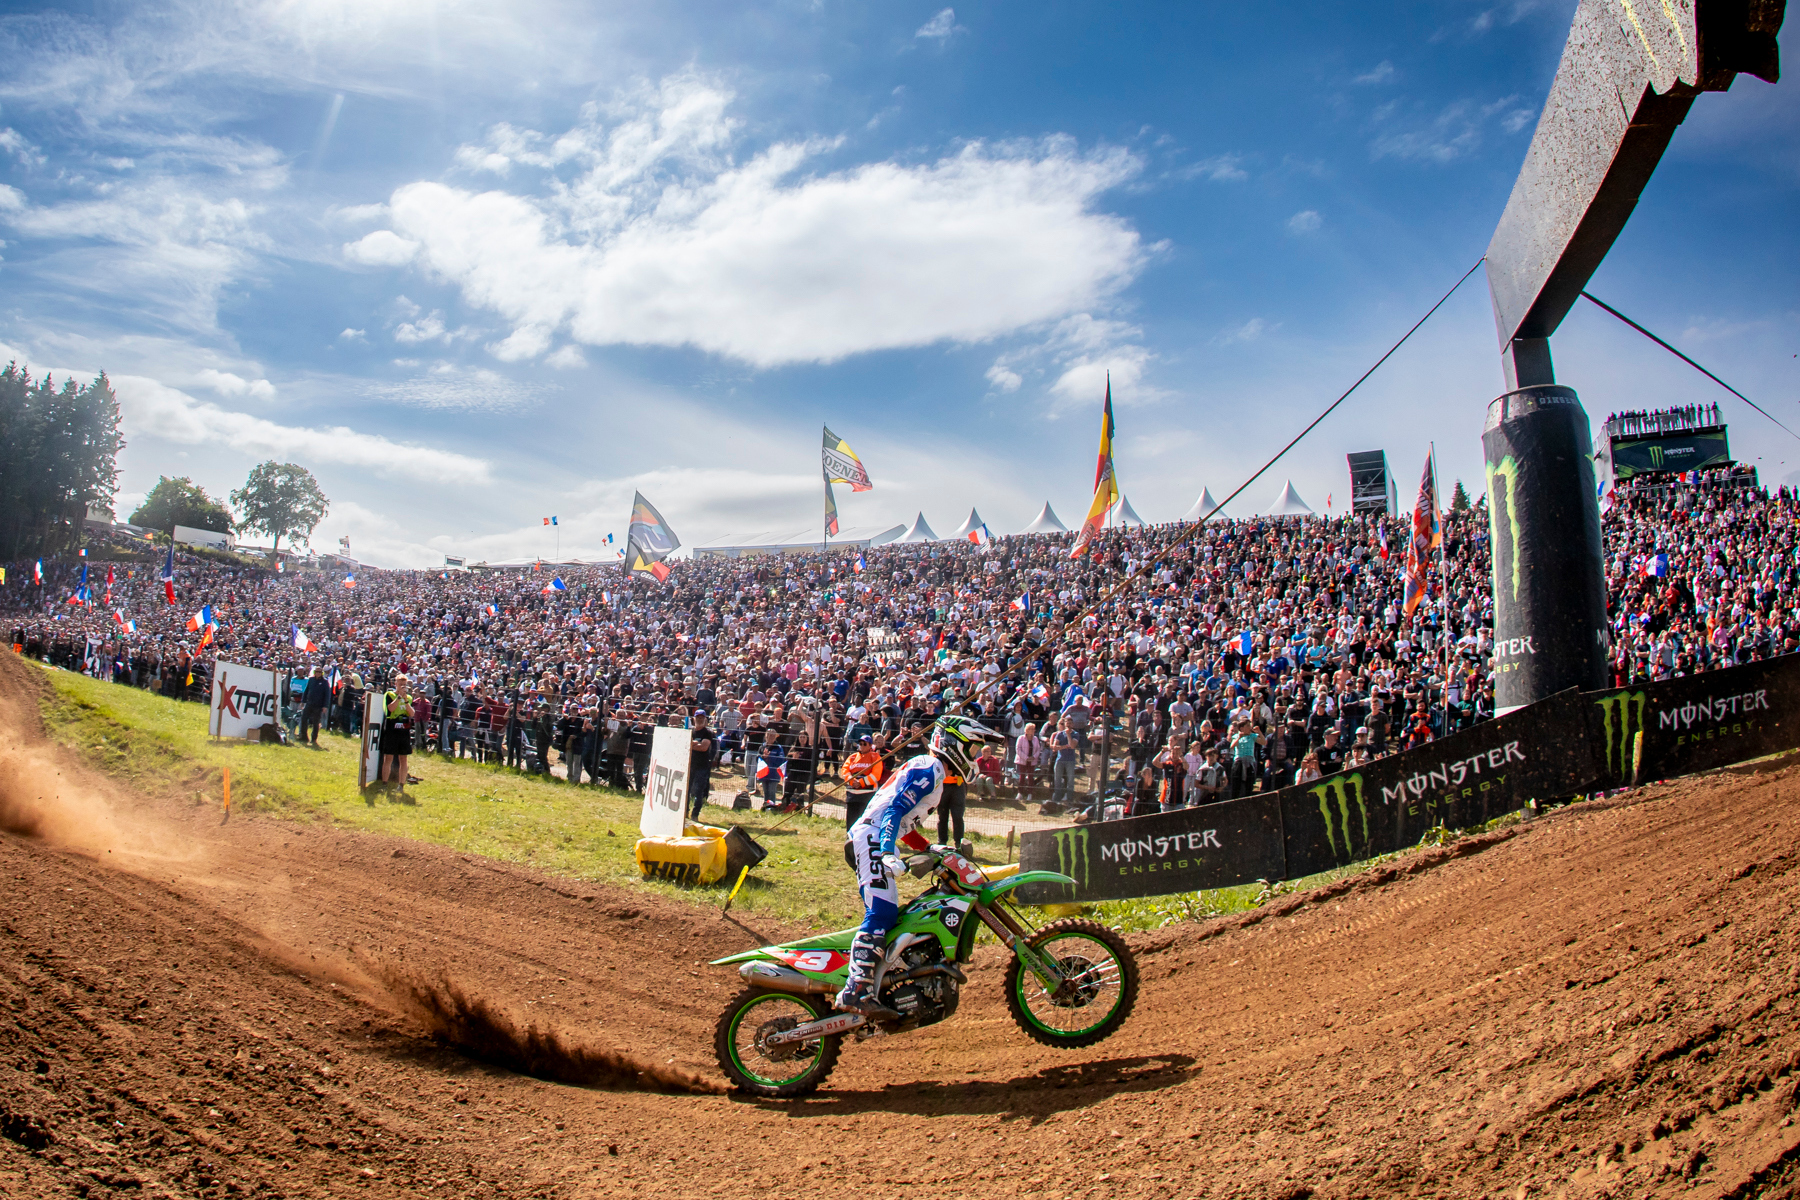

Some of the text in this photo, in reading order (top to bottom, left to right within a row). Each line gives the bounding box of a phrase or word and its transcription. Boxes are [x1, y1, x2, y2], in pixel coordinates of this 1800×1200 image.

[1494, 635, 1536, 662] STER
[1495, 661, 1520, 674] RGY
[216, 680, 280, 720] XTRIG
[1677, 720, 1754, 745] ENERGY
[647, 758, 685, 812] XTRIG
[1408, 774, 1507, 816] ENERGY
[1119, 857, 1203, 875] ENERGY
[794, 951, 833, 971] 3
